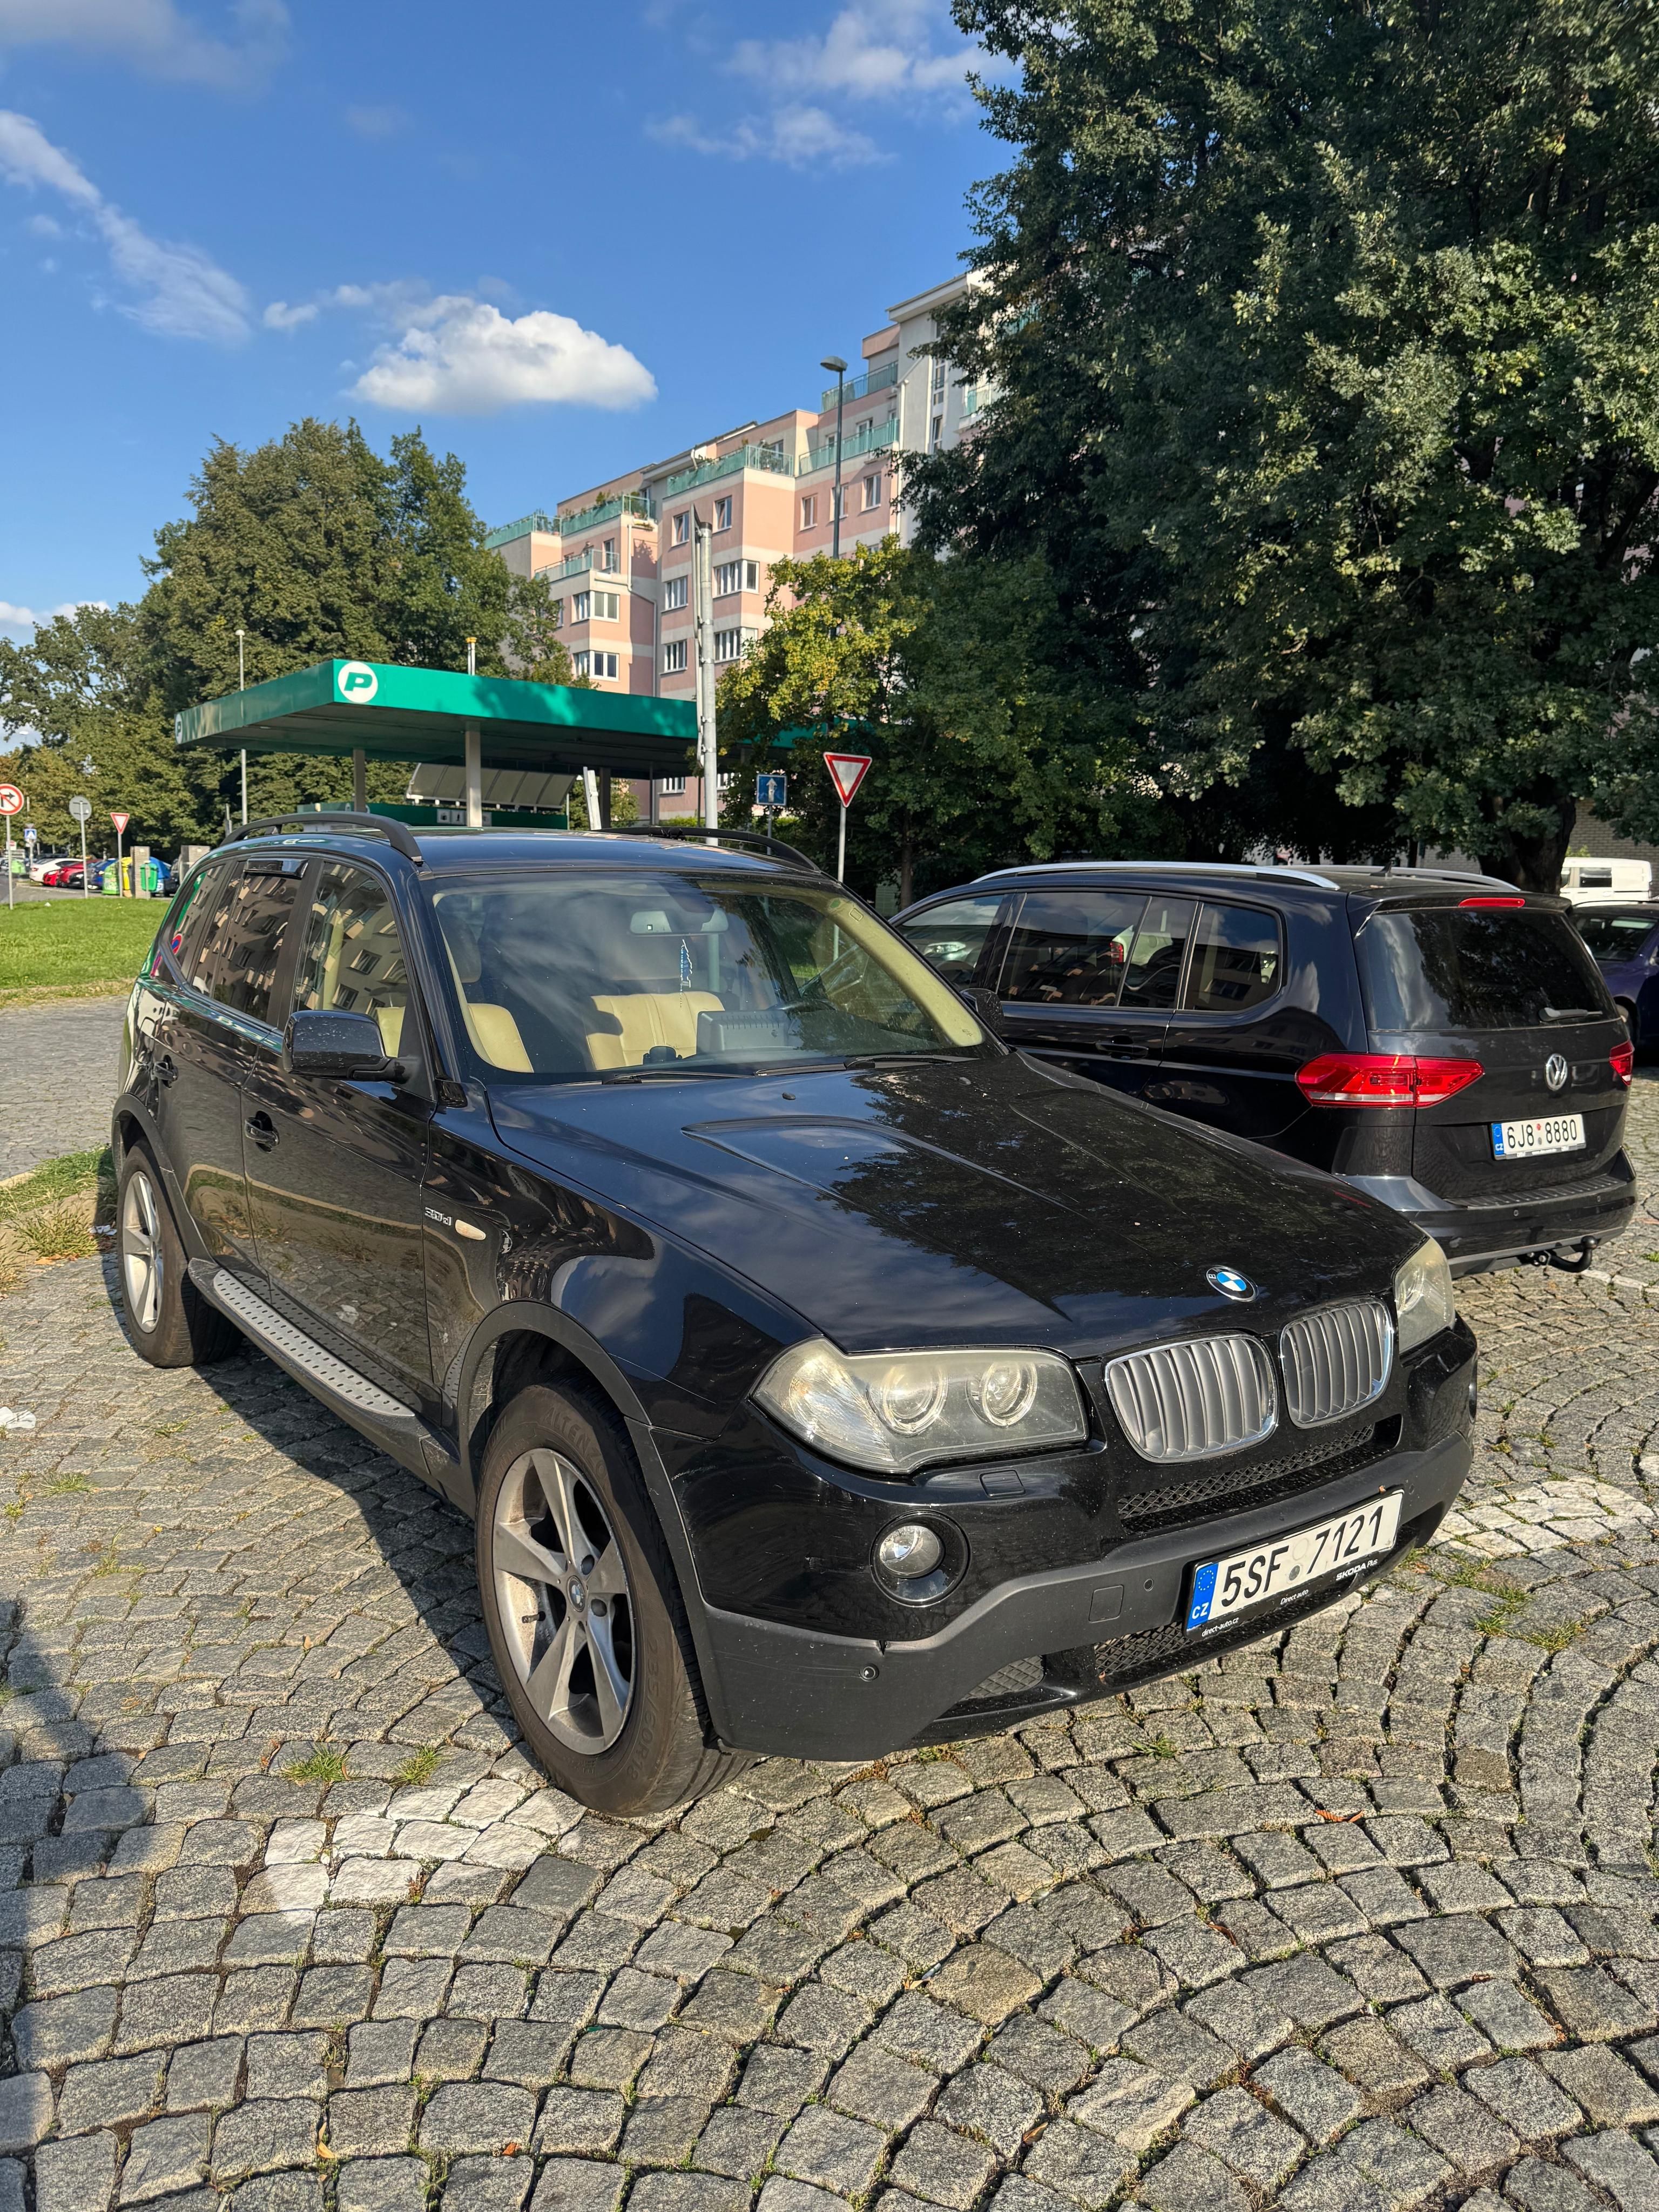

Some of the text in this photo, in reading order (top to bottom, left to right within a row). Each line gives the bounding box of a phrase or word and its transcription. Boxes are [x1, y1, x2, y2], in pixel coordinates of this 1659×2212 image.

[344, 672, 373, 691] P
[1507, 1119, 1577, 1149] 6J8 8880
[1495, 1143, 1503, 1151] CZ
[1221, 1505, 1384, 1608] 5SF 7121
[1191, 1602, 1209, 1620] CZ
